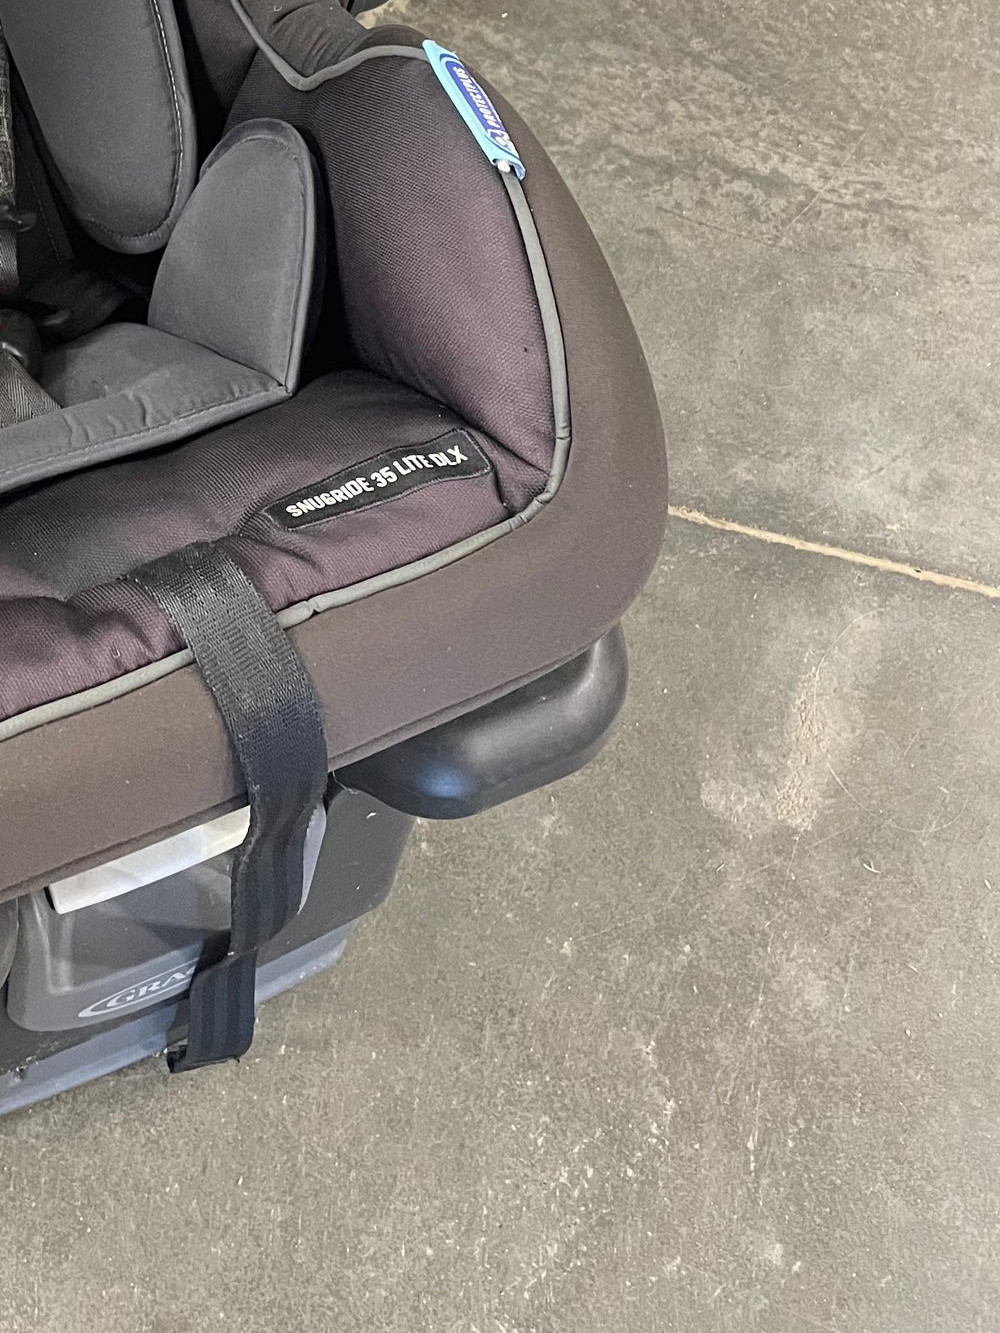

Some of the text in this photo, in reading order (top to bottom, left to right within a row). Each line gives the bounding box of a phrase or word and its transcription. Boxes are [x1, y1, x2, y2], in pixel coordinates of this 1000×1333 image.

[453, 66, 501, 128] PROTECTPLUS
[285, 445, 468, 518] SNUGRIDE 35 LITE DLX
[106, 965, 197, 1007] GRA
